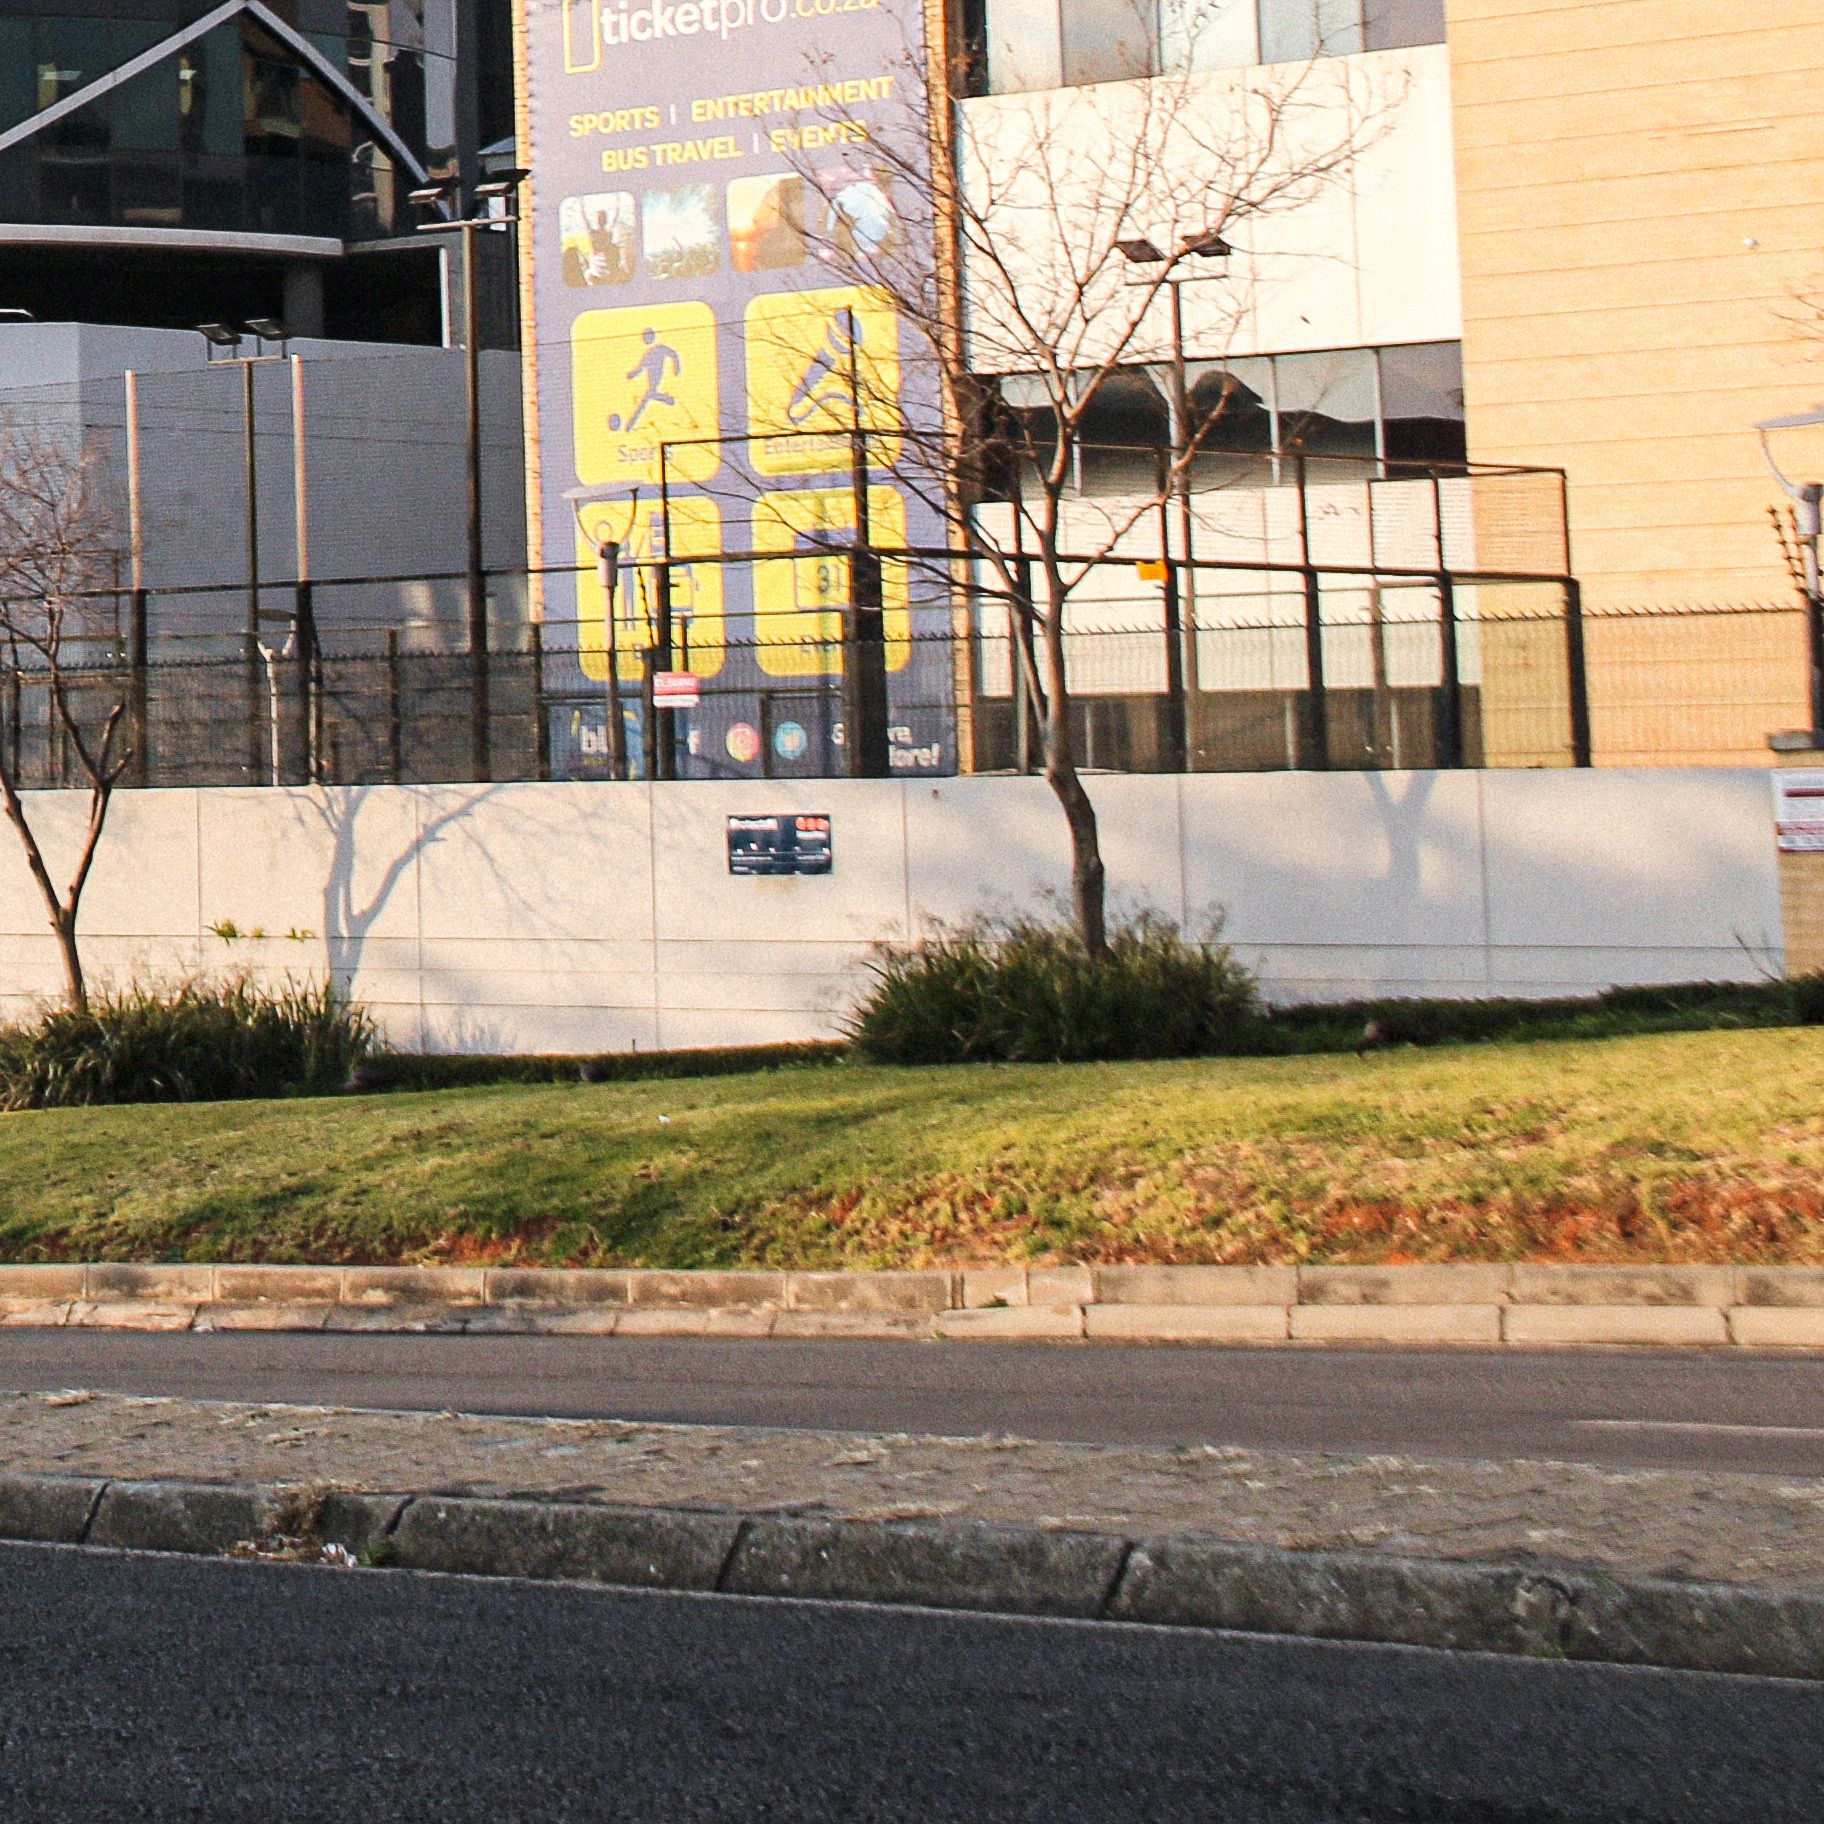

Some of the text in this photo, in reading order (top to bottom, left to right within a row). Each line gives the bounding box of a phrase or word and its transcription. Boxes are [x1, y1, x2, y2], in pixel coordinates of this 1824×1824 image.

[568, 105, 661, 138] SPORTS
[690, 76, 895, 124] ENTERTAINMENT
[601, 146, 649, 173] BUS
[652, 135, 743, 165] TRAVEL
[770, 119, 868, 153] EVENTS
